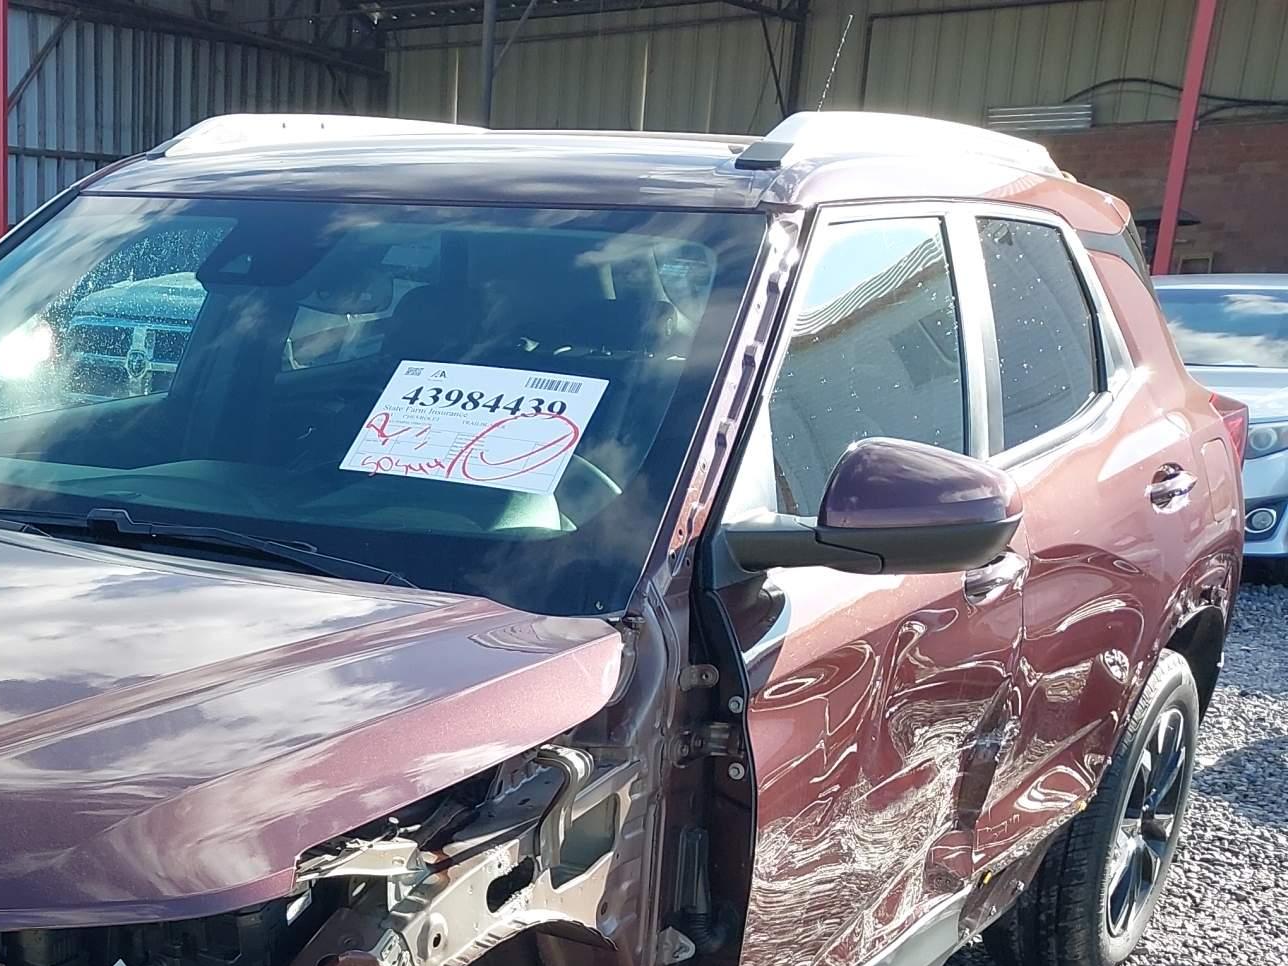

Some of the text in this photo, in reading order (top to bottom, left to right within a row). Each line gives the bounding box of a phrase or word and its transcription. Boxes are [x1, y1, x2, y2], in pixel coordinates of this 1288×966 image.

[383, 404, 469, 418] State Farm Insurance
[401, 386, 567, 420] 43984439
